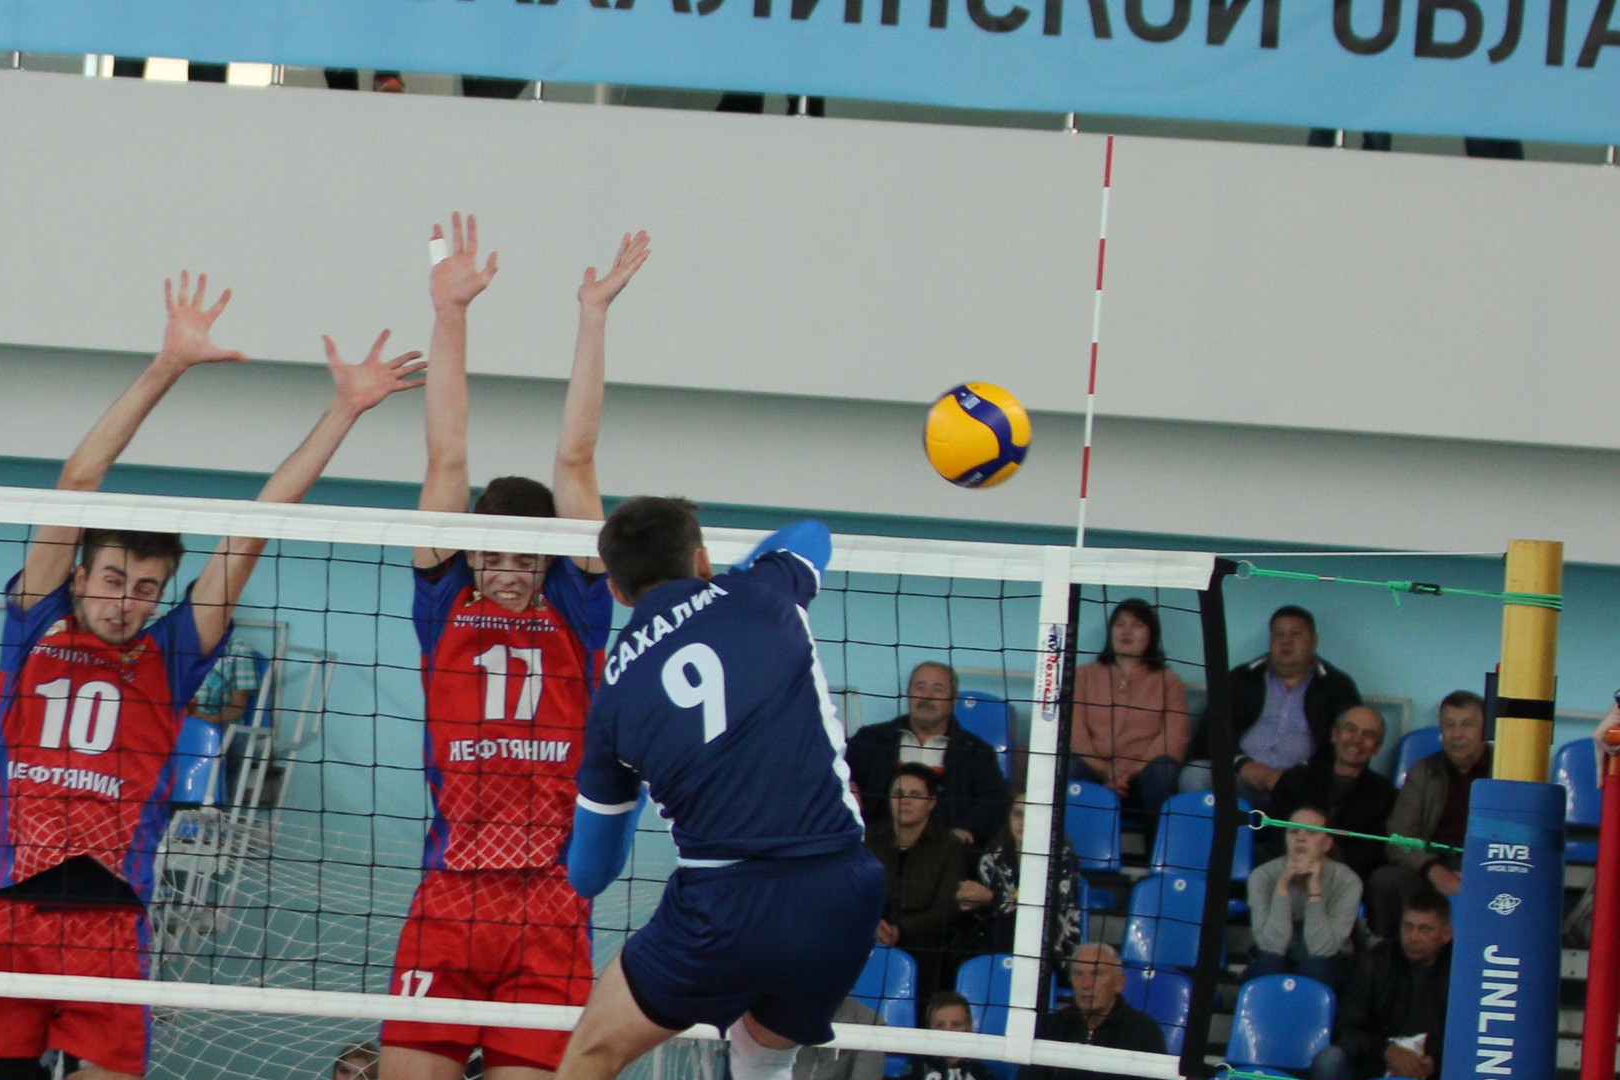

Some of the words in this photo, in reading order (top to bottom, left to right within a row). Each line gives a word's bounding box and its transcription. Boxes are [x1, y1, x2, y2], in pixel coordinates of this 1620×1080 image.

[35, 677, 121, 755] 10
[473, 644, 543, 721] 17
[661, 642, 727, 744] 9
[449, 738, 571, 763] НЕФТЯНИК
[400, 969, 434, 998] 17
